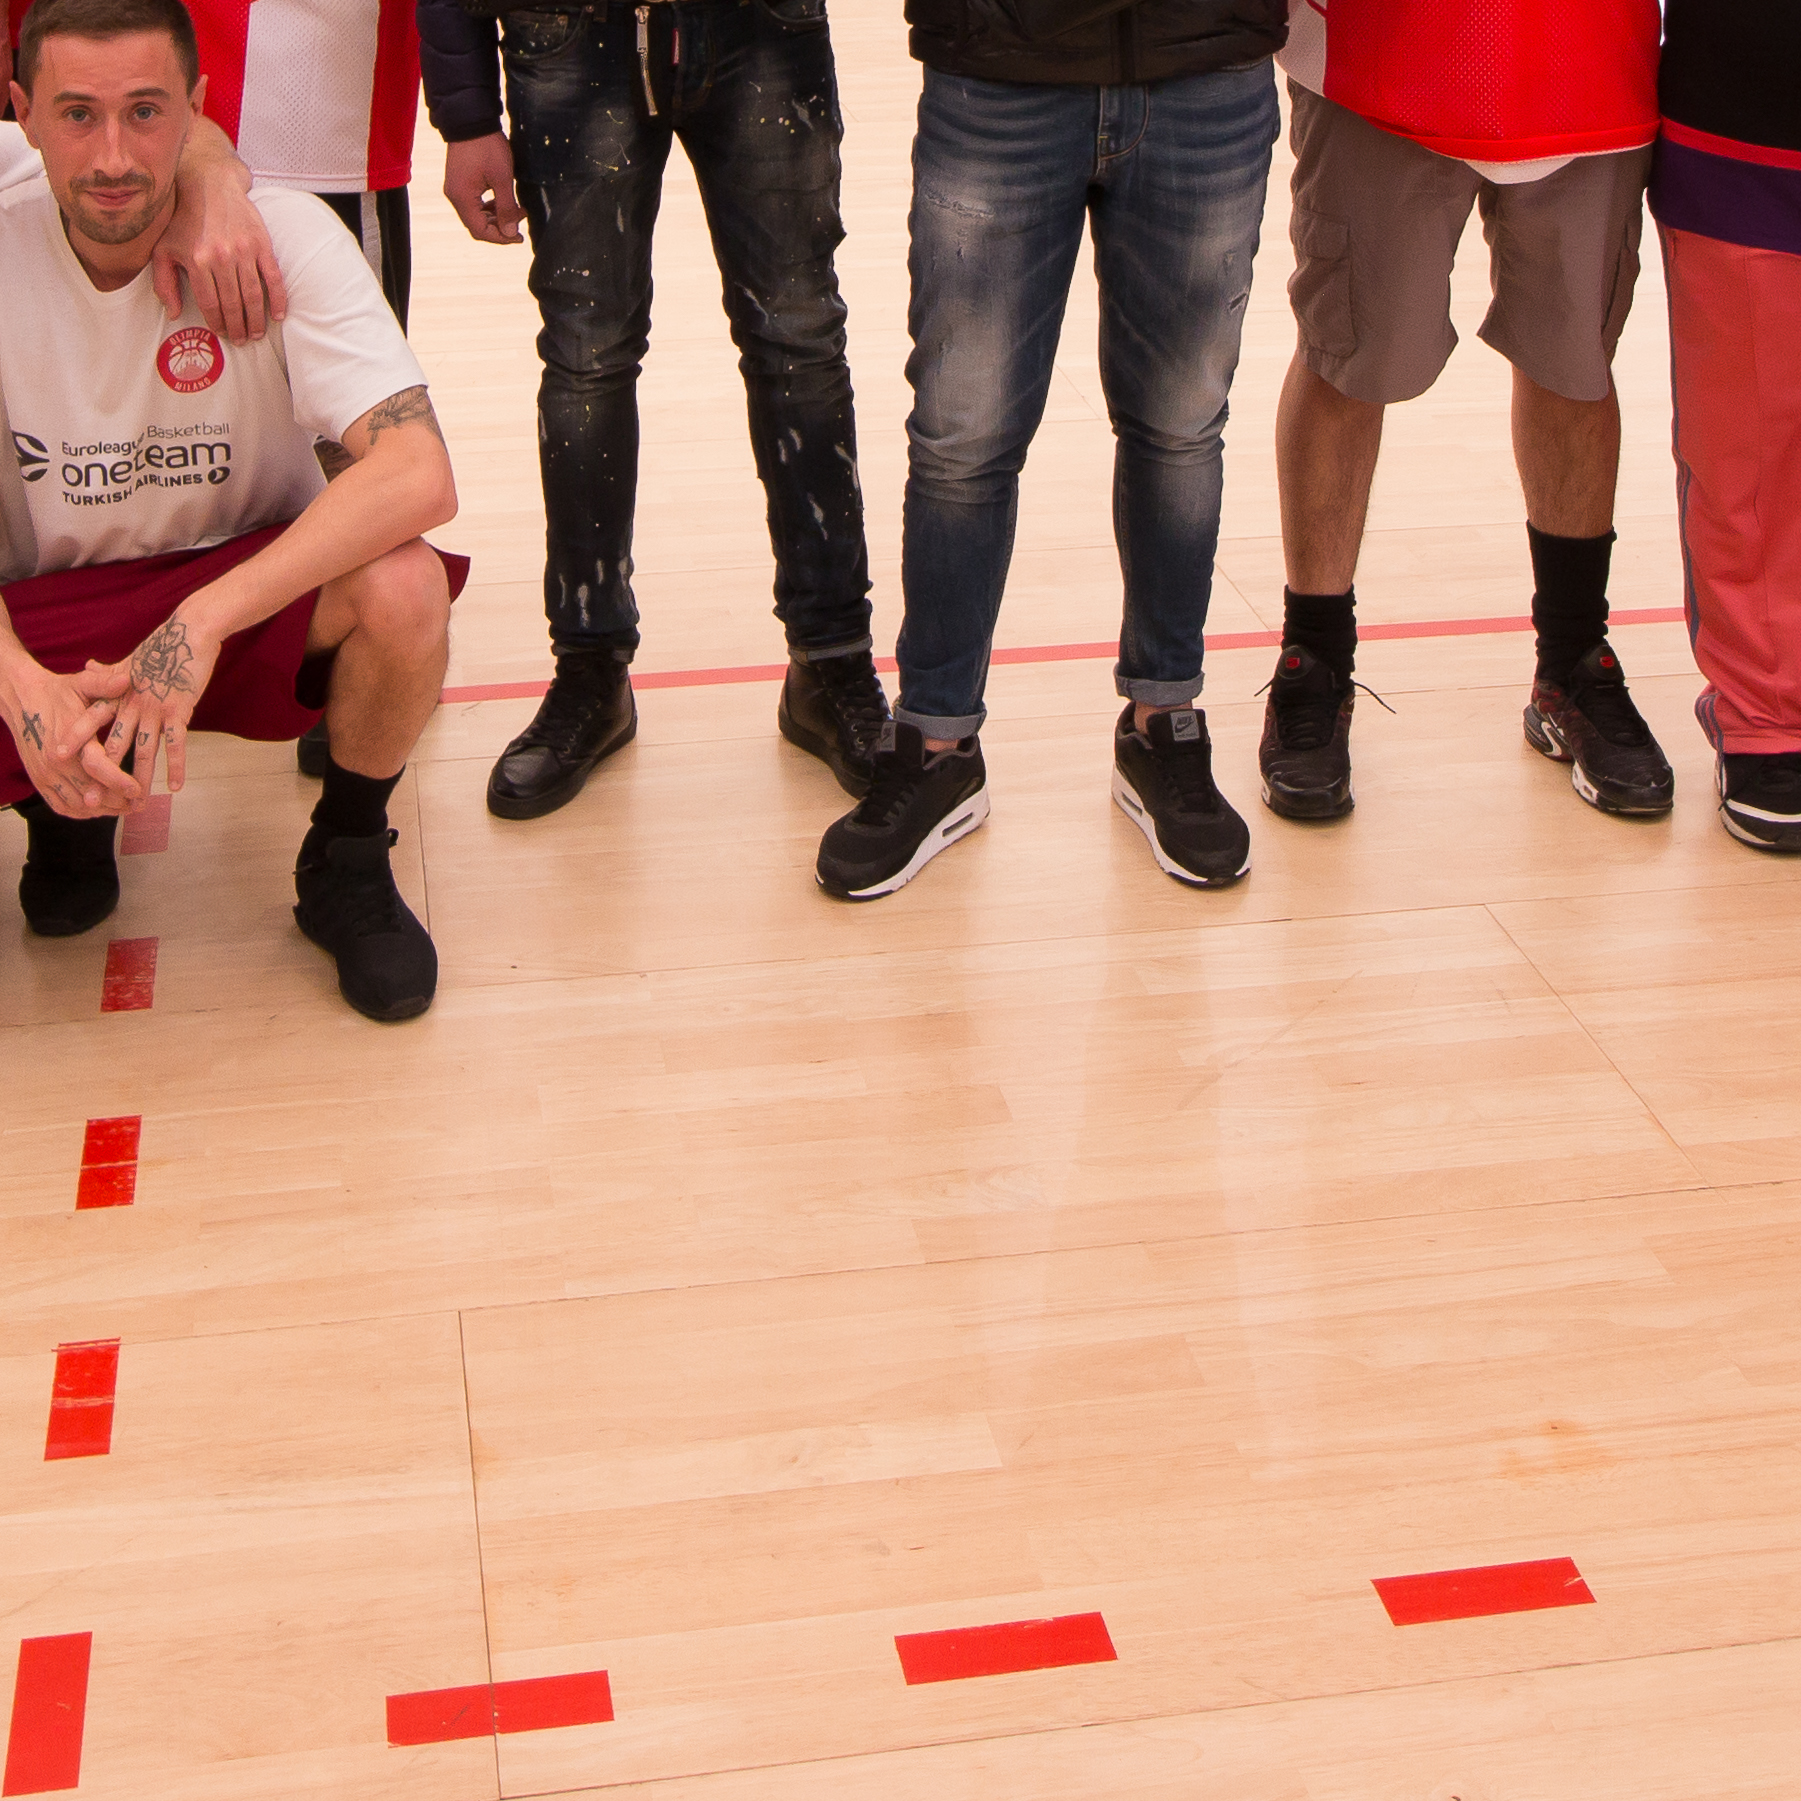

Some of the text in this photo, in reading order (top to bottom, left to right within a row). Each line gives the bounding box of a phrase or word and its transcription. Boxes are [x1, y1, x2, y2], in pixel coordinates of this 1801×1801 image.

[169, 329, 211, 346] OLIMPIA
[174, 376, 211, 391] MILANO
[146, 421, 230, 440] Basketball
[61, 442, 232, 488] oneteam
[62, 473, 203, 506] TURKISH AIRLINES
